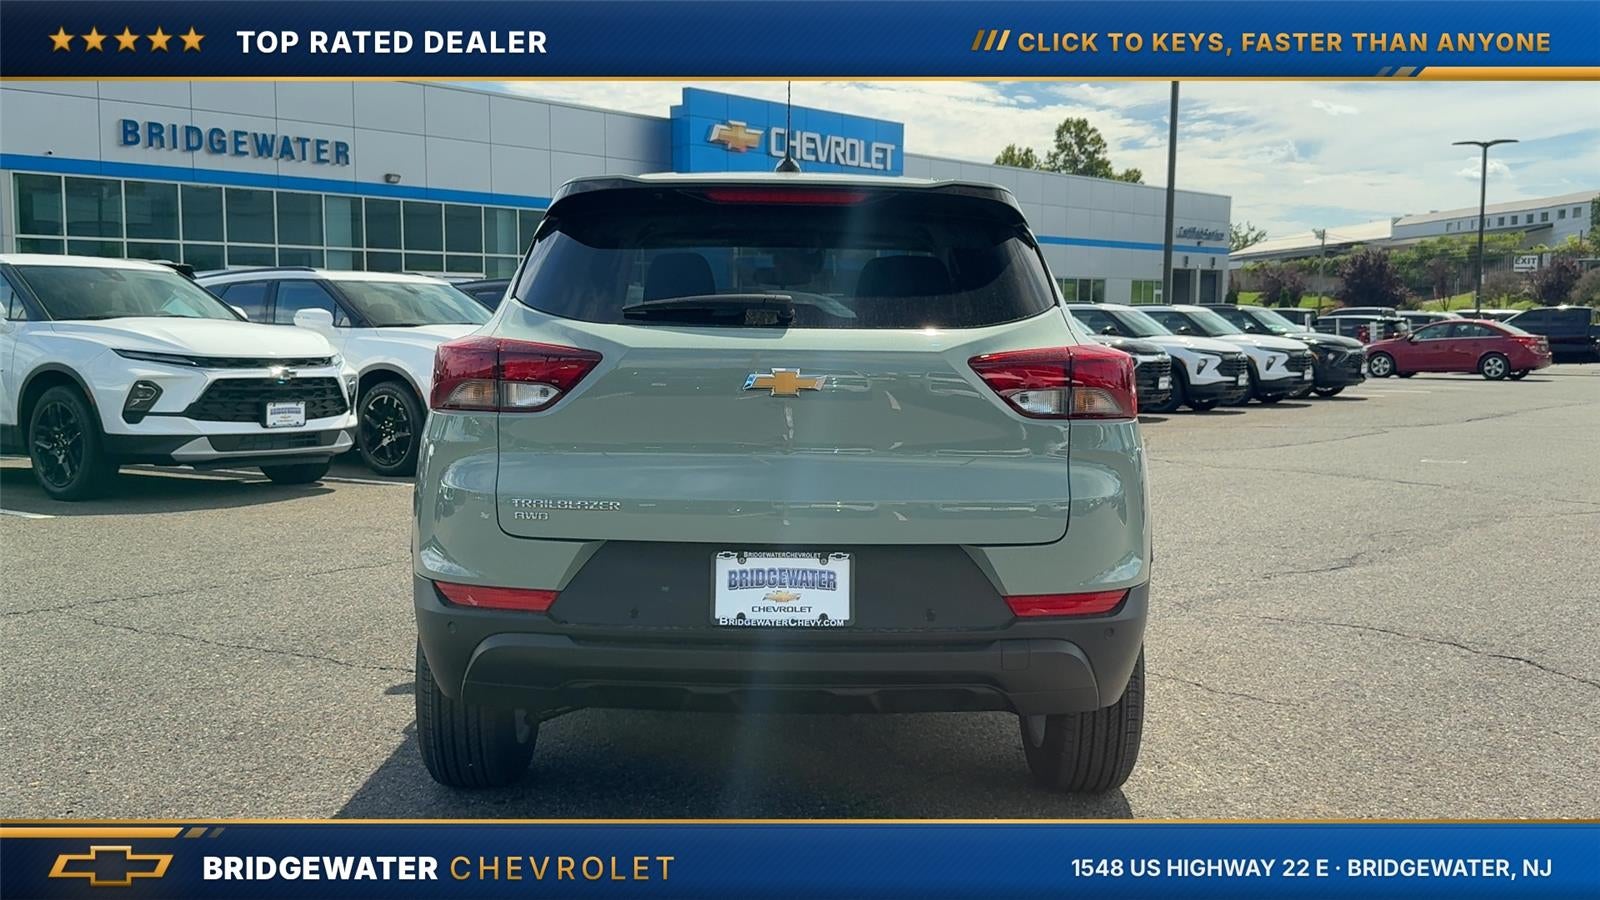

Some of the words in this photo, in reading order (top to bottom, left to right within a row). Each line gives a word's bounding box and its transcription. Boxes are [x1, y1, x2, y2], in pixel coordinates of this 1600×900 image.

[119, 118, 350, 165] BRIDGEWATER
[770, 127, 896, 171] CHEVROLET
[1515, 257, 1536, 265] EXIT
[512, 498, 621, 511] TRAILBLAZER
[514, 511, 549, 521] AWD
[727, 567, 838, 591] BRIDGEWATER
[751, 605, 813, 613] CHEVROLET
